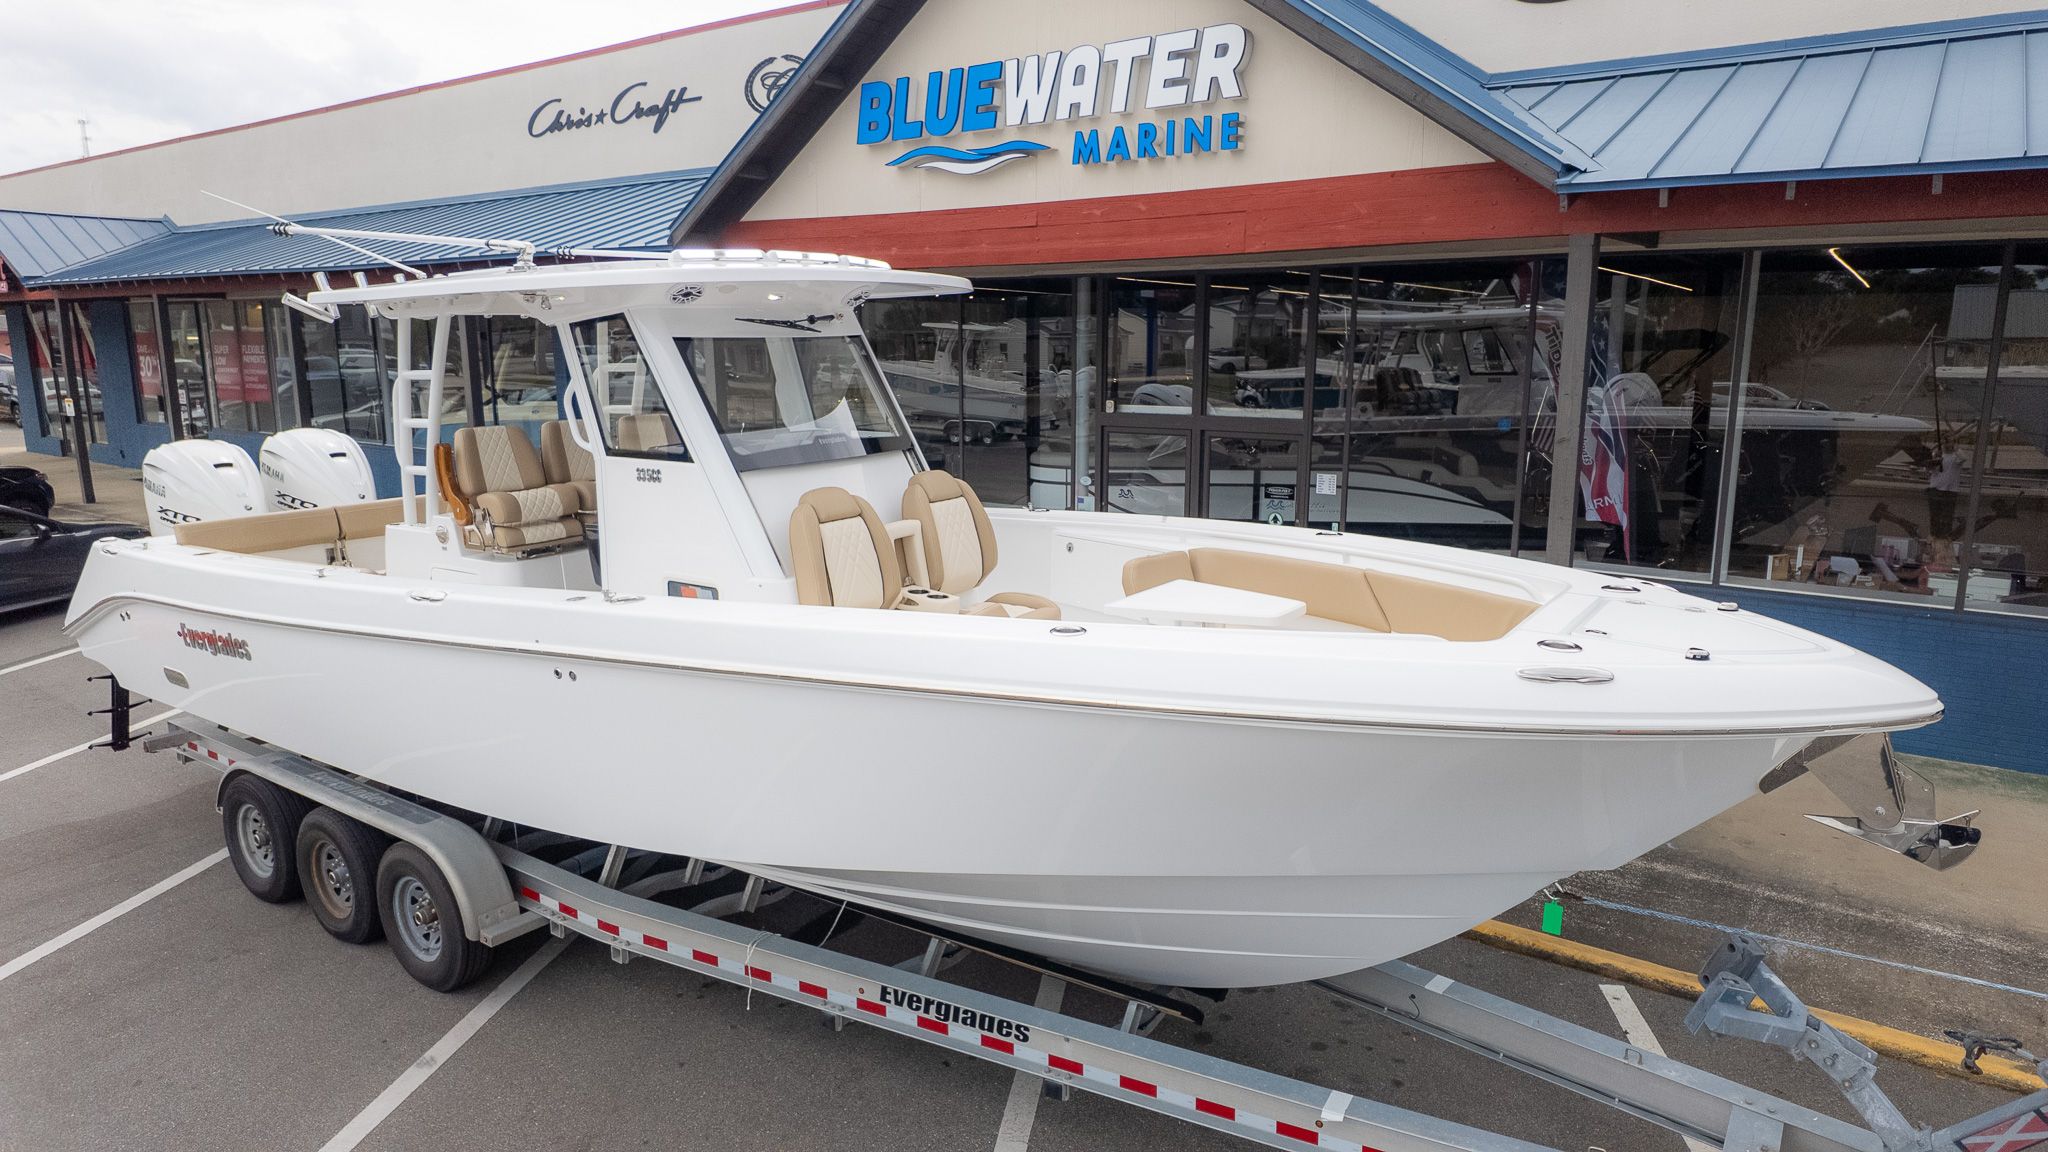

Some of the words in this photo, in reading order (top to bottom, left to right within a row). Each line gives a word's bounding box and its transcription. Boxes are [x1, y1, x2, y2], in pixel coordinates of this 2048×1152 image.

[527, 98, 593, 138] Chris
[610, 81, 703, 134] Craft
[856, 22, 1248, 145] BLUEWATER
[1071, 111, 1243, 166] MARINE
[179, 622, 252, 661] Everglades
[879, 984, 1031, 1043] Everglades
